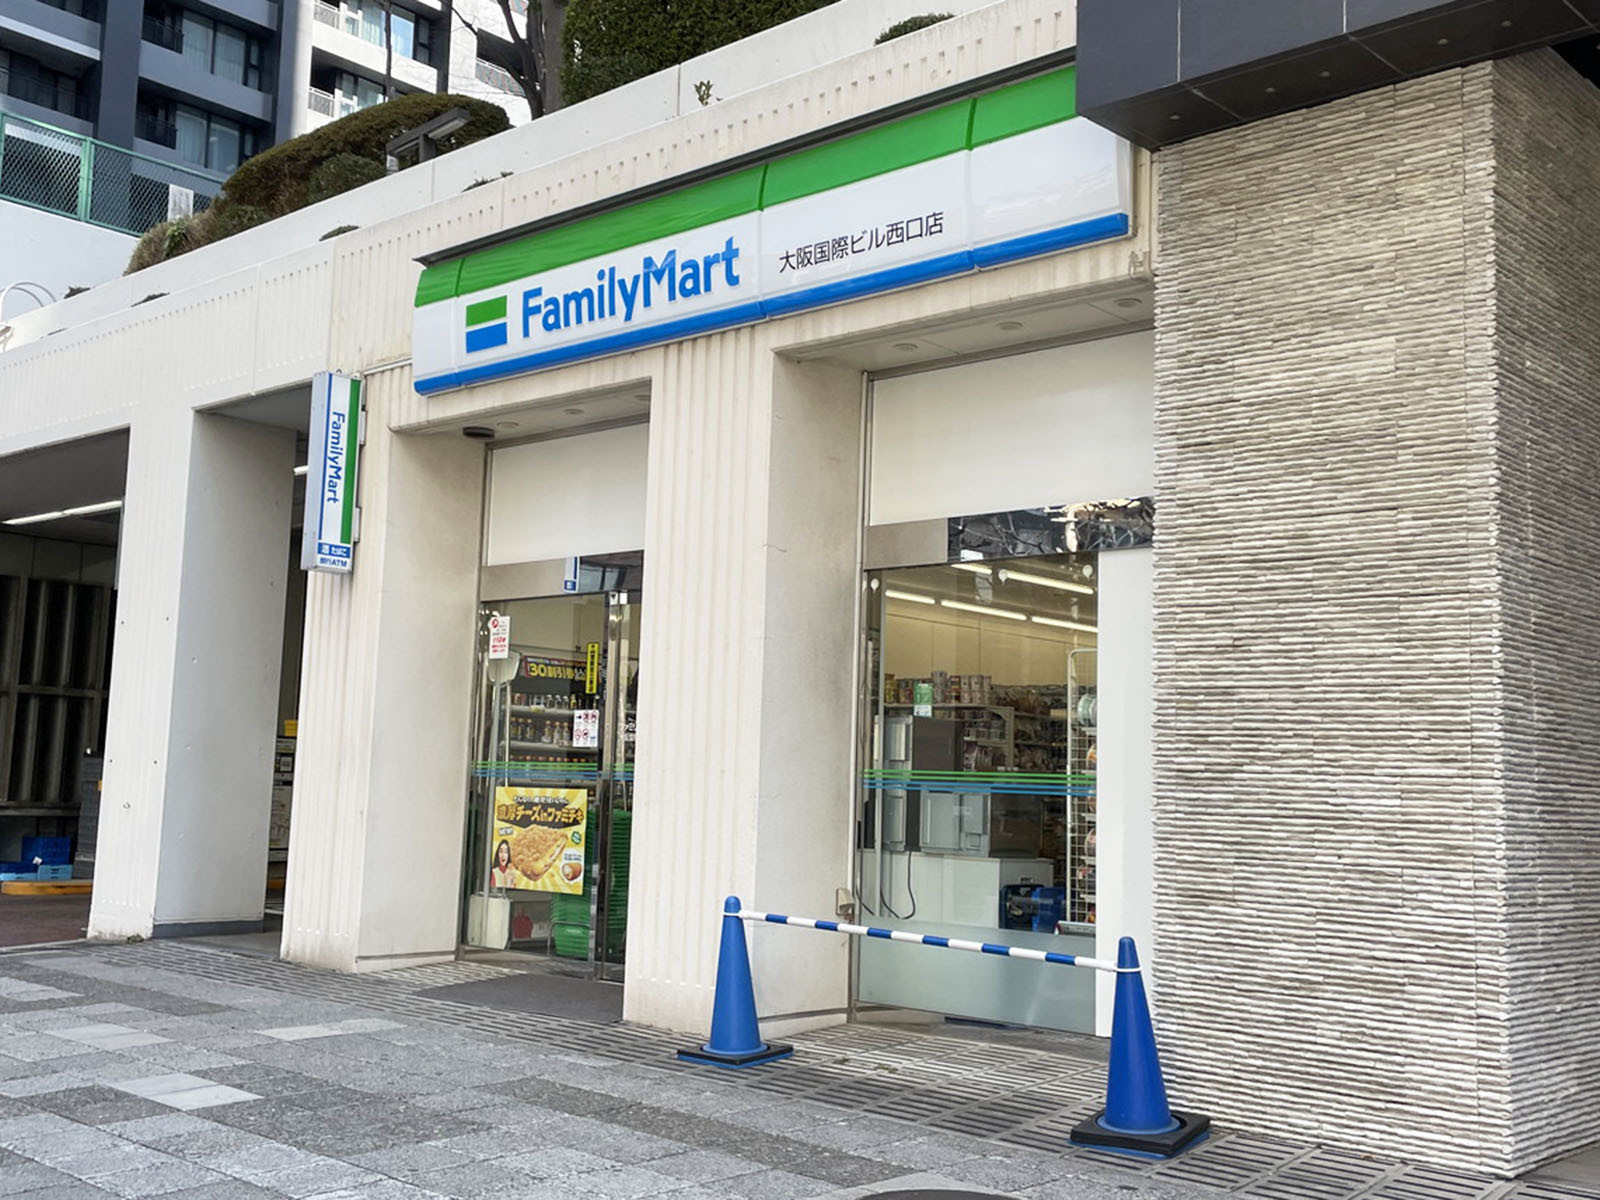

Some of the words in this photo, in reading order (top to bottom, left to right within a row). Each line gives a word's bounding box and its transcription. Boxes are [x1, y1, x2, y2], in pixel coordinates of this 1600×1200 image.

[522, 235, 740, 339] FamilyMart
[779, 211, 944, 274] 大阪国際ビル西口店
[326, 411, 346, 504] FamilyMart
